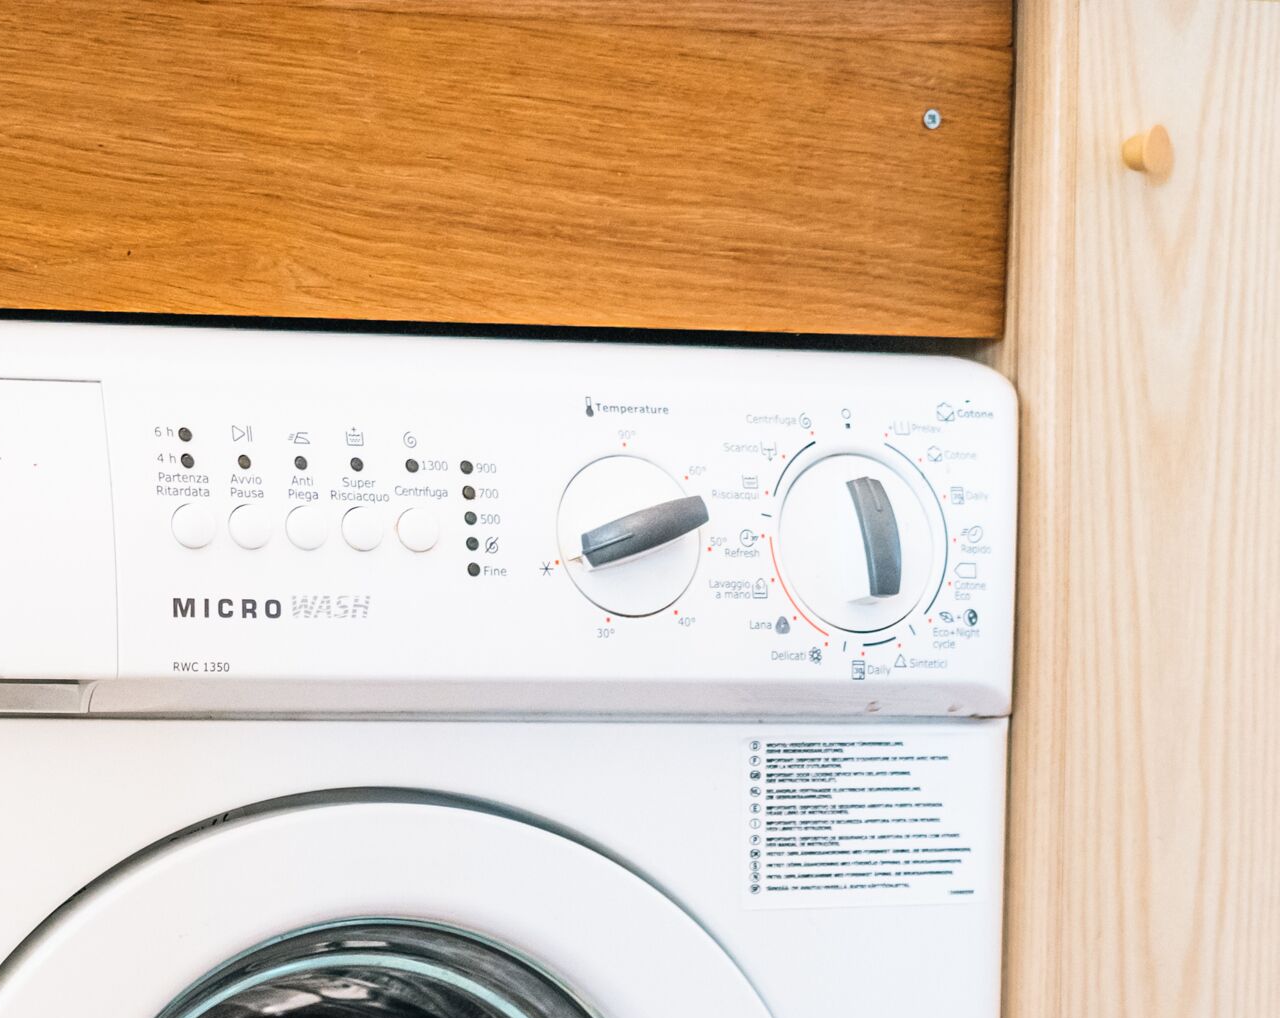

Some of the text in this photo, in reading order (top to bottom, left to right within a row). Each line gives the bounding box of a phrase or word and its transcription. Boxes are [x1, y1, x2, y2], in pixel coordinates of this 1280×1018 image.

[595, 402, 669, 415] Temperature
[957, 408, 994, 419] Cotone
[745, 414, 797, 426] Centrifuga
[154, 426, 174, 437] 6 h
[723, 442, 759, 453] Scarico
[157, 453, 176, 463] 4 h
[944, 449, 977, 460] Cotone
[421, 460, 448, 471] 1300
[476, 463, 496, 473] 900
[158, 472, 209, 484] Partenza
[230, 474, 262, 485] Avvio
[291, 475, 314, 487] Anti
[342, 477, 376, 489] Super
[156, 485, 210, 497] Ritardata
[230, 487, 264, 498] Pausa
[288, 488, 319, 502] Piega
[330, 490, 390, 503] Risciacquo
[394, 485, 449, 500] Centrifuga
[479, 488, 499, 499] 700
[480, 514, 501, 525] 500
[724, 547, 760, 558] Refresh
[483, 565, 507, 577] Fine
[708, 579, 751, 591] Lavaggio
[954, 580, 986, 591] Cotone
[724, 591, 751, 599] mano
[954, 591, 970, 600] Eco
[172, 595, 370, 619] MICRO WASH
[749, 619, 773, 630] Lana
[933, 639, 955, 649] cycle
[771, 650, 807, 661] Delicati
[173, 661, 230, 672] RWC 1350
[909, 658, 947, 669] Sintetici
[867, 664, 891, 675] Daily
